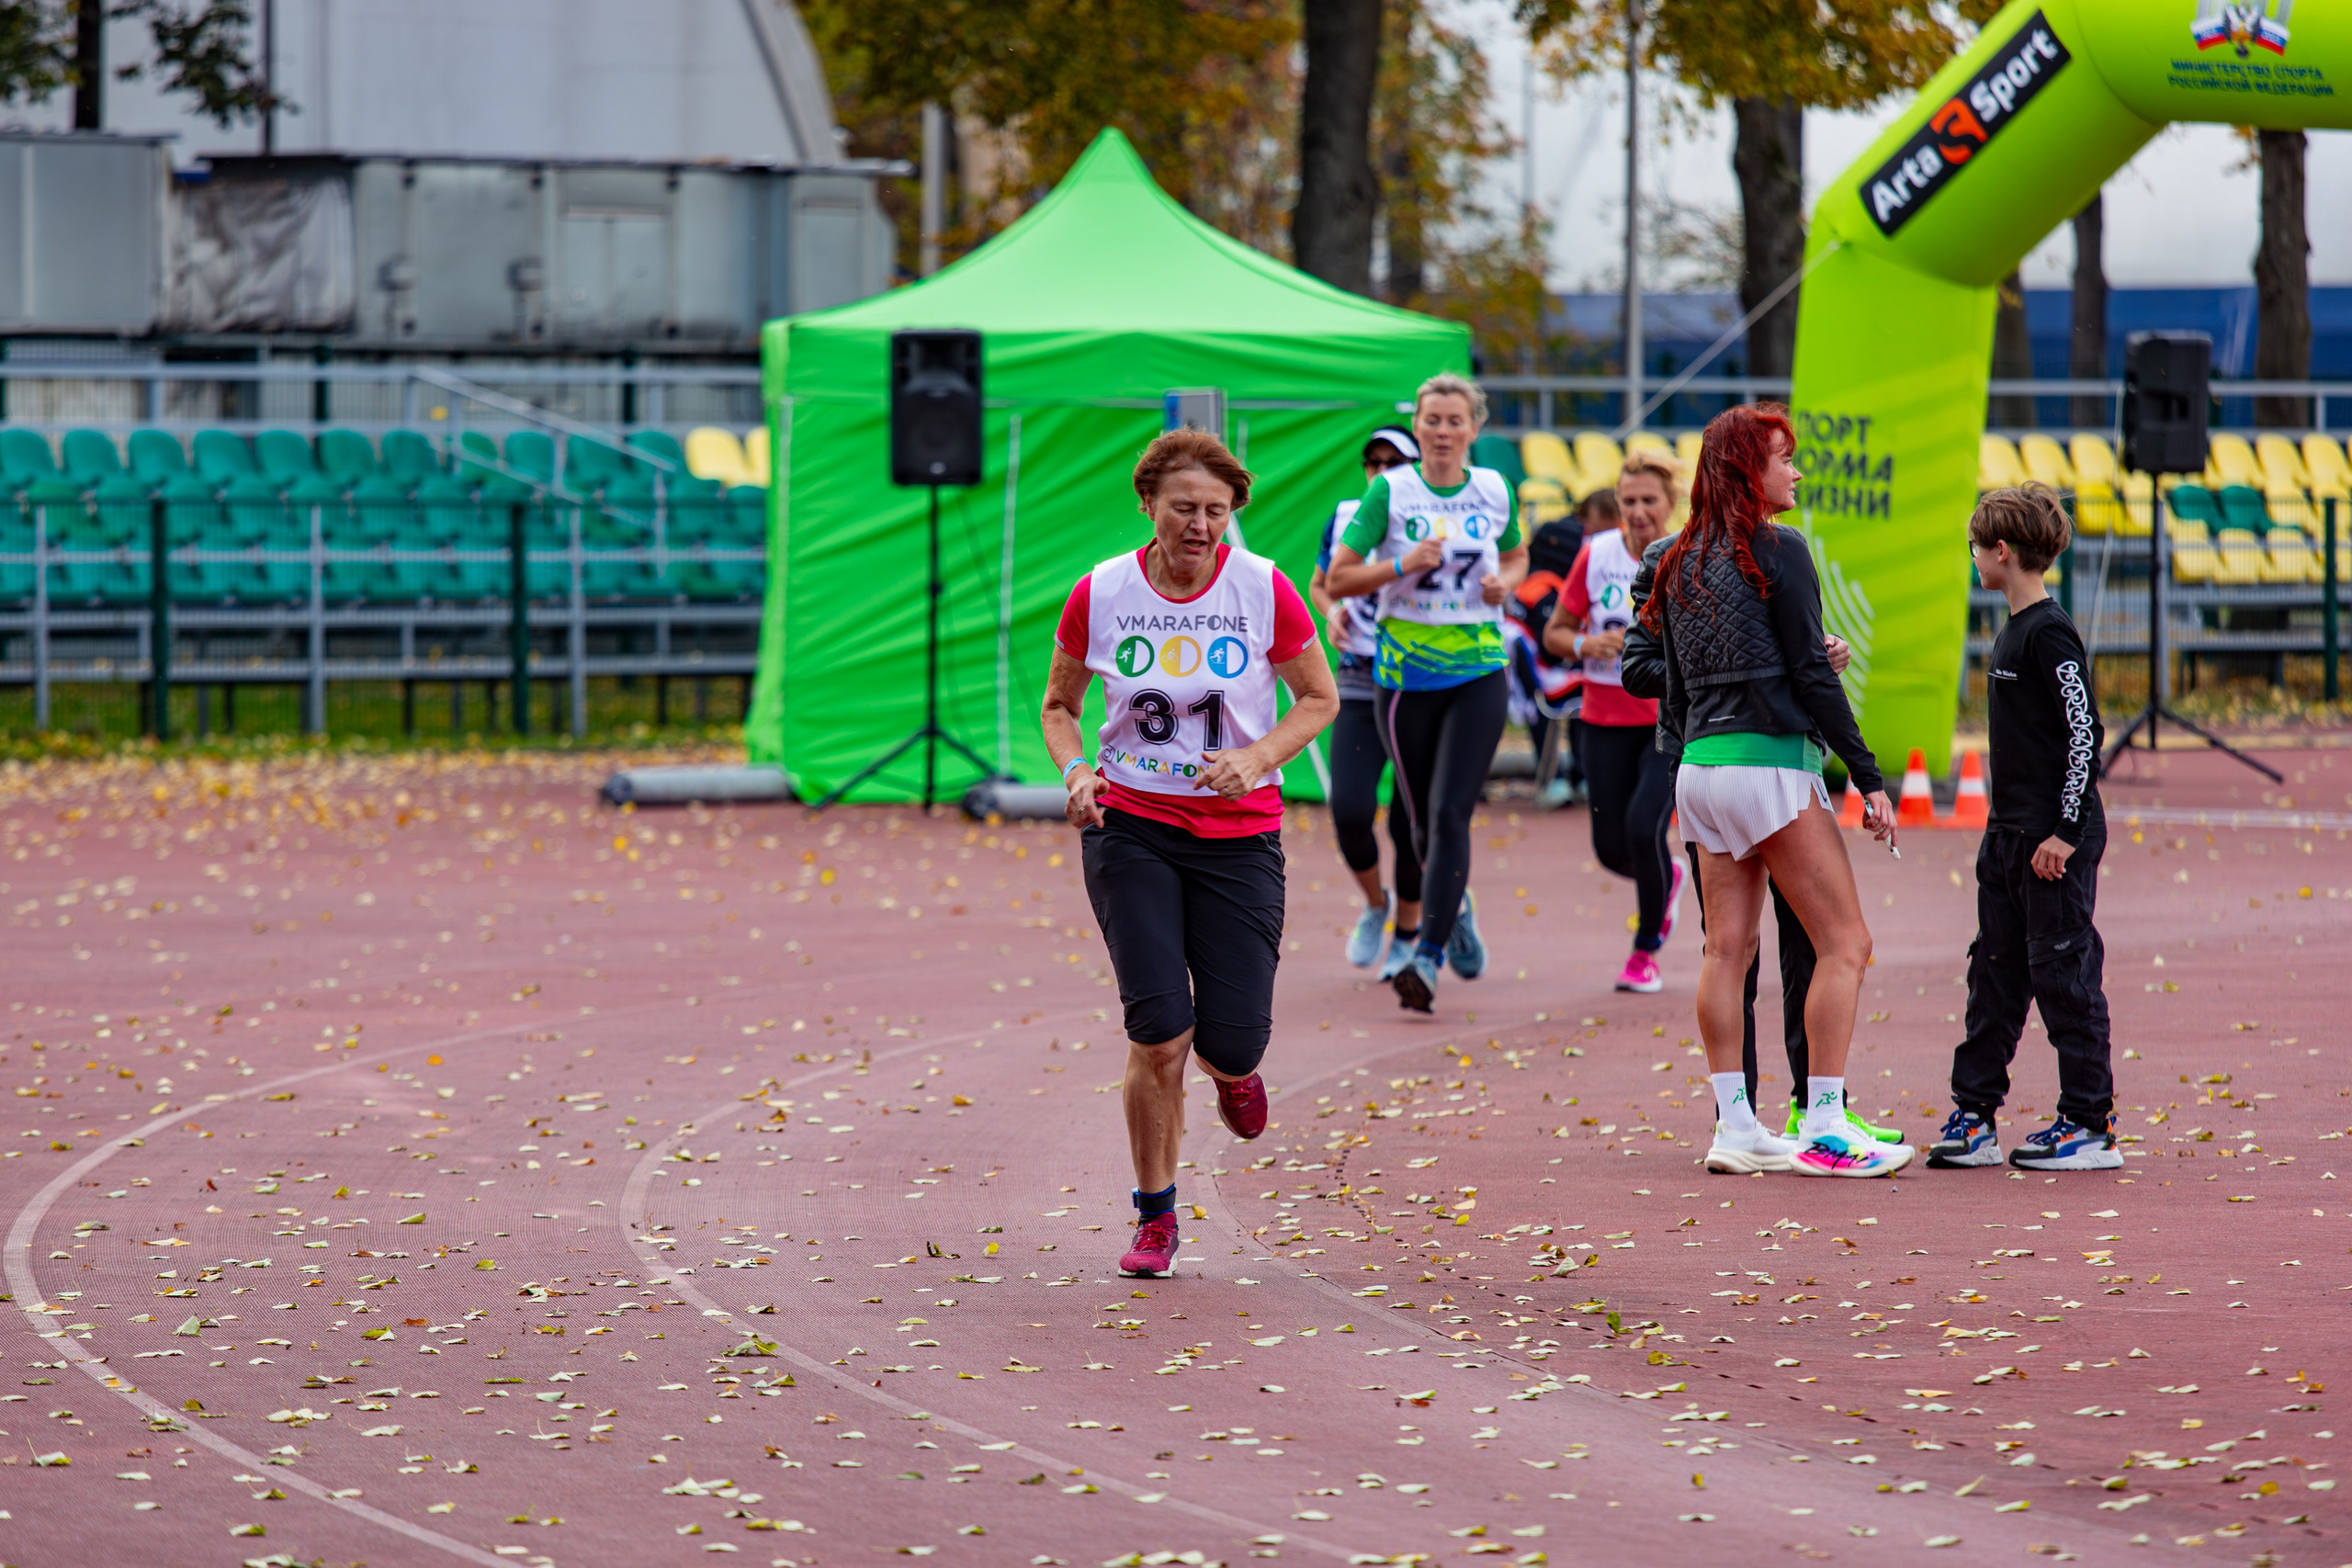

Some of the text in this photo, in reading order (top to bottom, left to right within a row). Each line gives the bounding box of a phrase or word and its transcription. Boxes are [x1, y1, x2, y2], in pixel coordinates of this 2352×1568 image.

[1871, 28, 2059, 223] Arta Sport
[1794, 447, 1893, 482] ОРМА
[1796, 484, 1891, 521] ИЗНИ
[1415, 549, 1483, 593] 27
[1116, 615, 1249, 632] VMARAFONE
[1129, 688, 1225, 751] 31
[1116, 750, 1213, 778] VMARAFON
